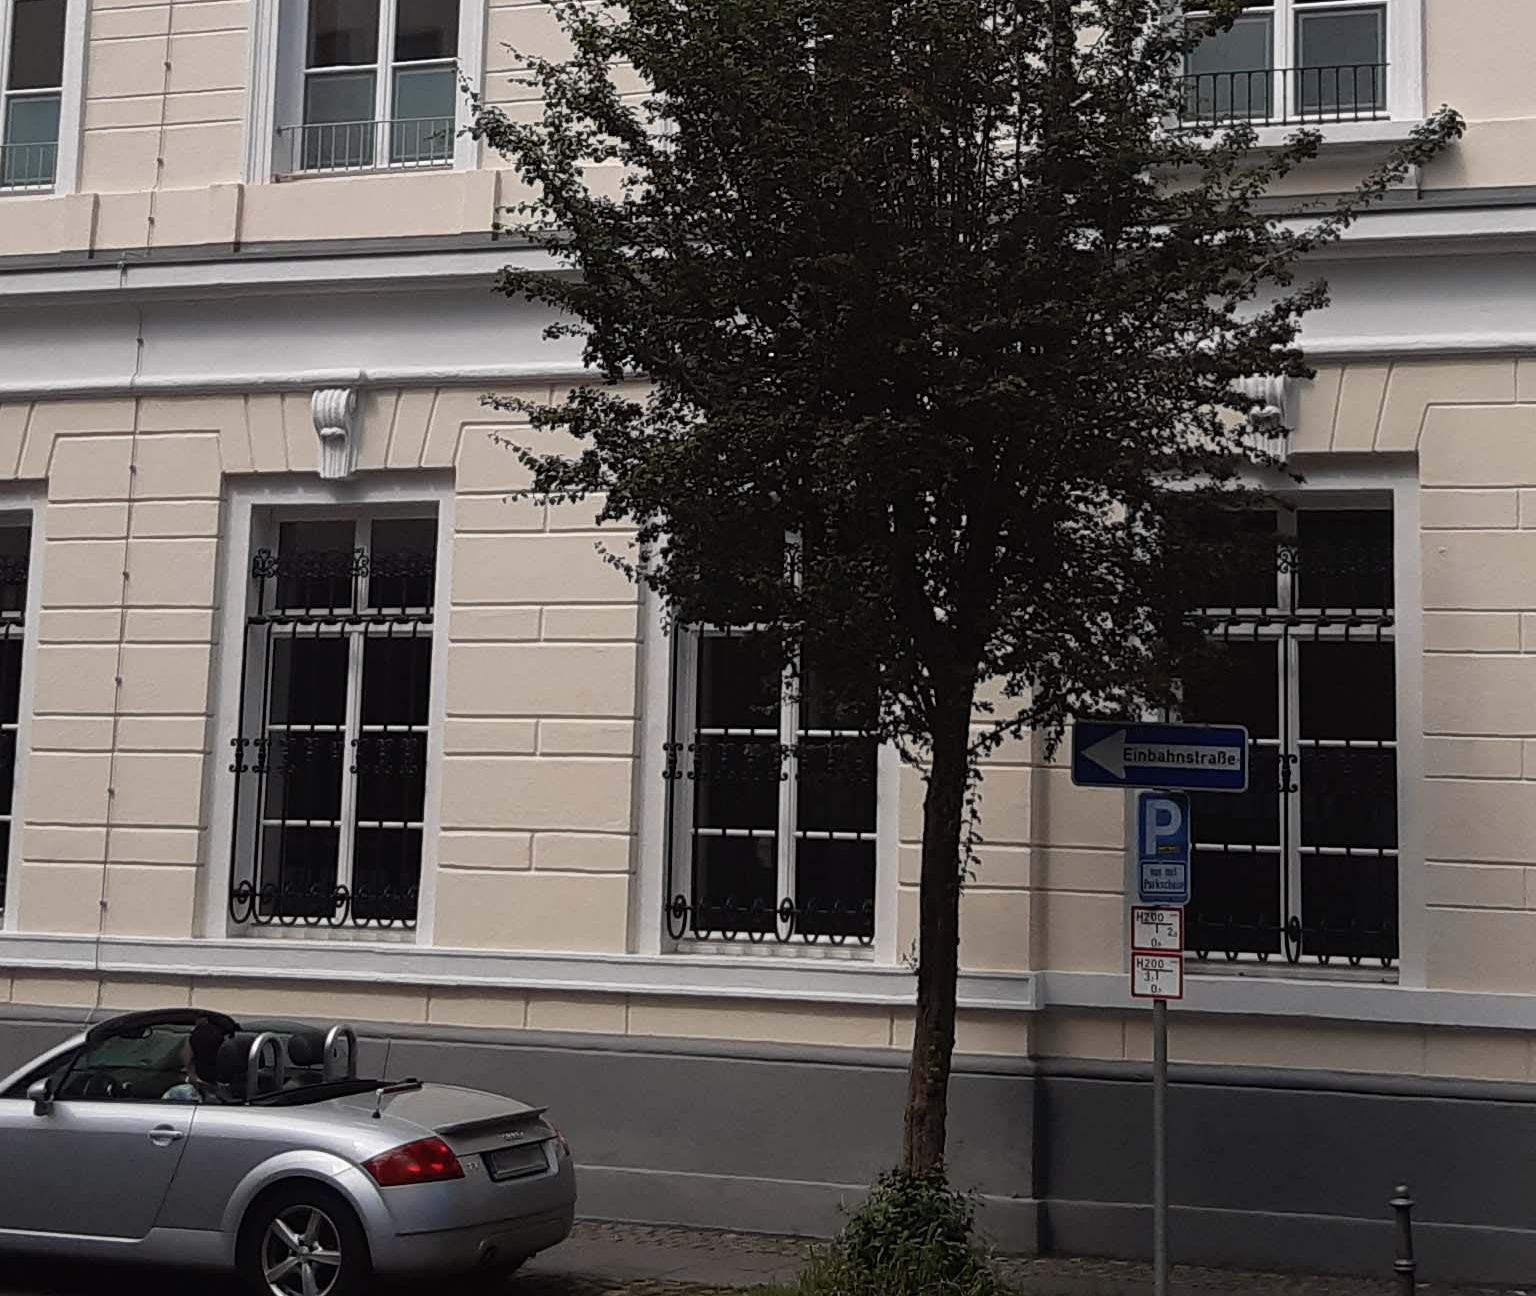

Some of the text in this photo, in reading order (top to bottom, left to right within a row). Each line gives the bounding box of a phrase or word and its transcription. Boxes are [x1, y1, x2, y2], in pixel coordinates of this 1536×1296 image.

[1123, 747, 1236, 766] Einbahnstraße
[1146, 799, 1182, 854] P
[1136, 911, 1164, 922] H200
[1136, 958, 1164, 969] H200
